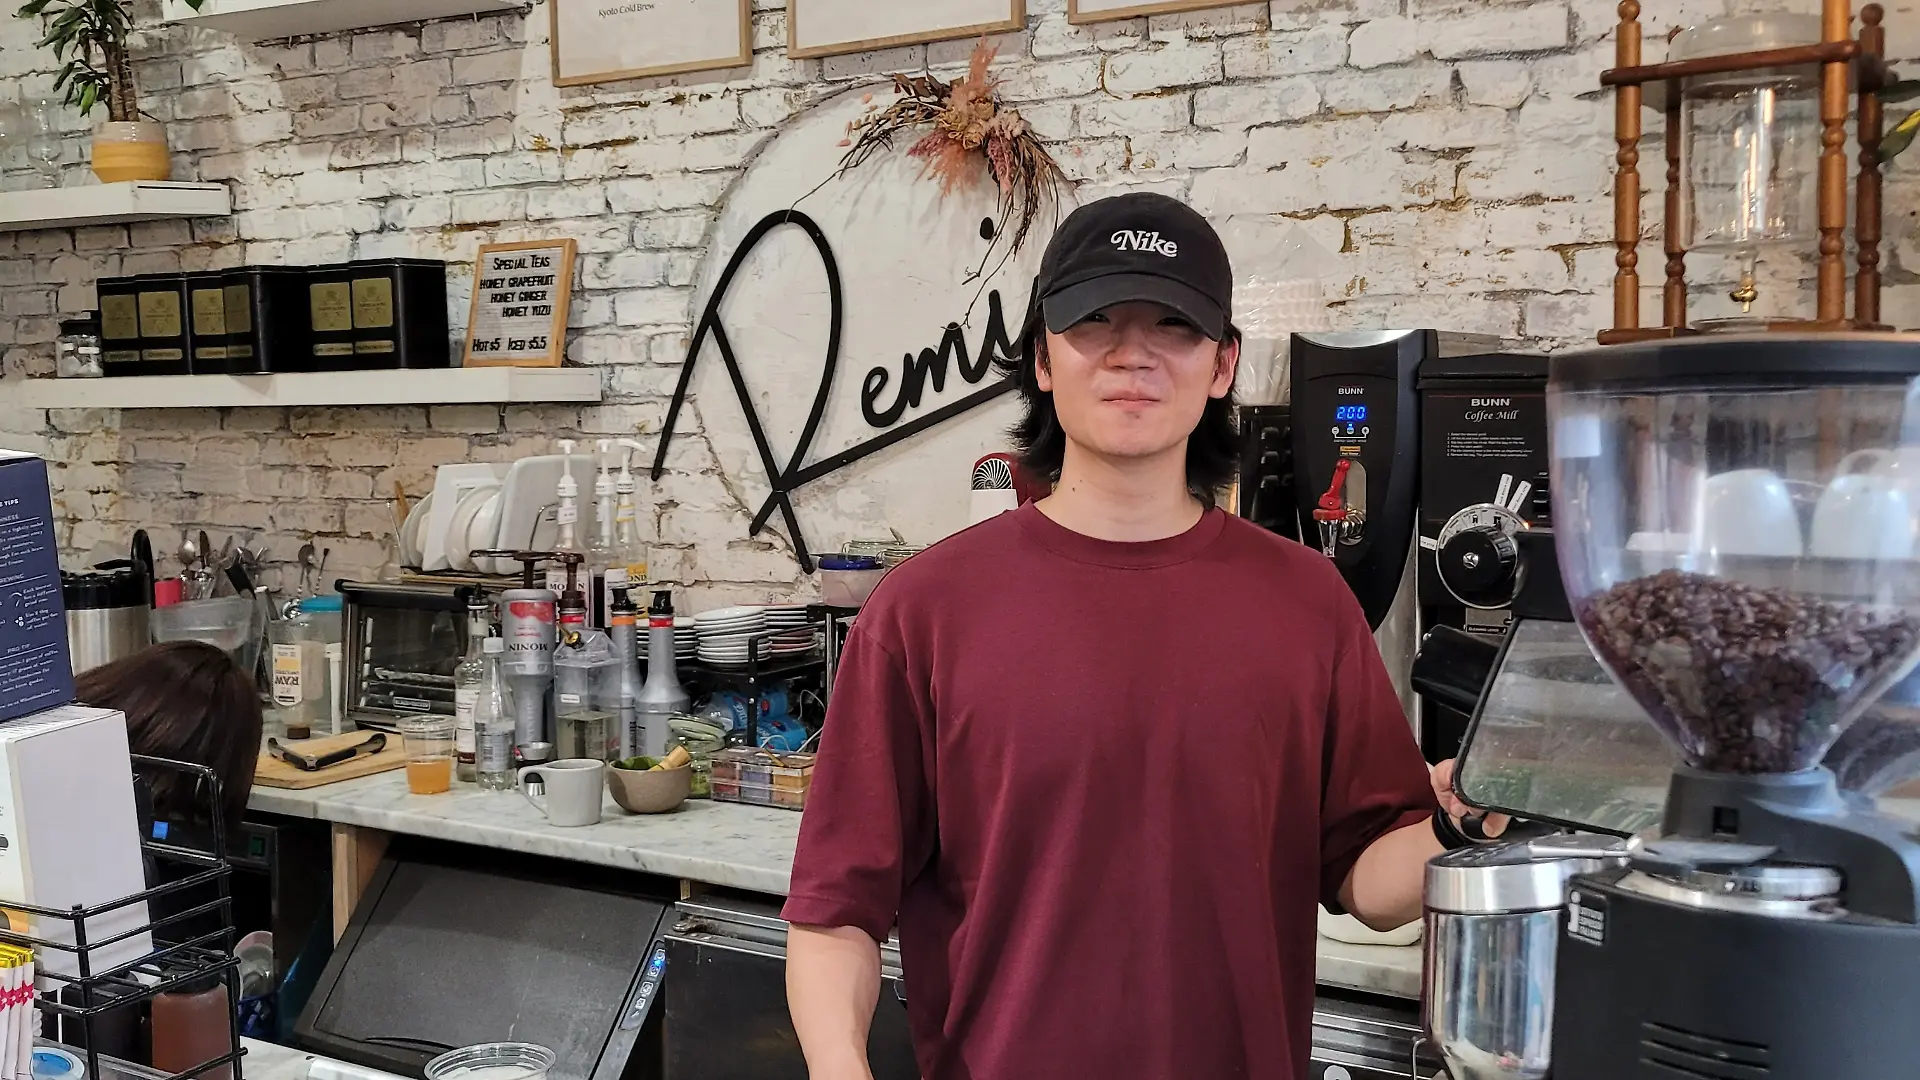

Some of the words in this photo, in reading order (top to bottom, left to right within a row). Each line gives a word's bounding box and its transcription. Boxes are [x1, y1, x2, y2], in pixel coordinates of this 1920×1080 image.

[598, 7, 618, 19] Kyoto
[619, 4, 636, 14] Cold
[637, 3, 656, 12] Brew
[1110, 229, 1178, 258] Nike
[493, 257, 528, 270] SPECIAL
[530, 254, 550, 268] TEAS
[480, 277, 505, 289] HONEY
[508, 274, 555, 288] GRAPEFRUIT
[490, 291, 516, 303] HONEY
[518, 290, 548, 302] GINGER
[502, 305, 528, 318] HONEY
[532, 304, 551, 316] YUZU
[1338, 387, 1364, 395] BUNN
[1471, 398, 1511, 407] BUNN
[1336, 406, 1366, 420] 200
[1464, 409, 1493, 423] Coffee
[1495, 409, 1519, 420] Mill
[549, 582, 585, 590] MON
[508, 642, 549, 652] MONIN
[274, 676, 299, 686] RAW
